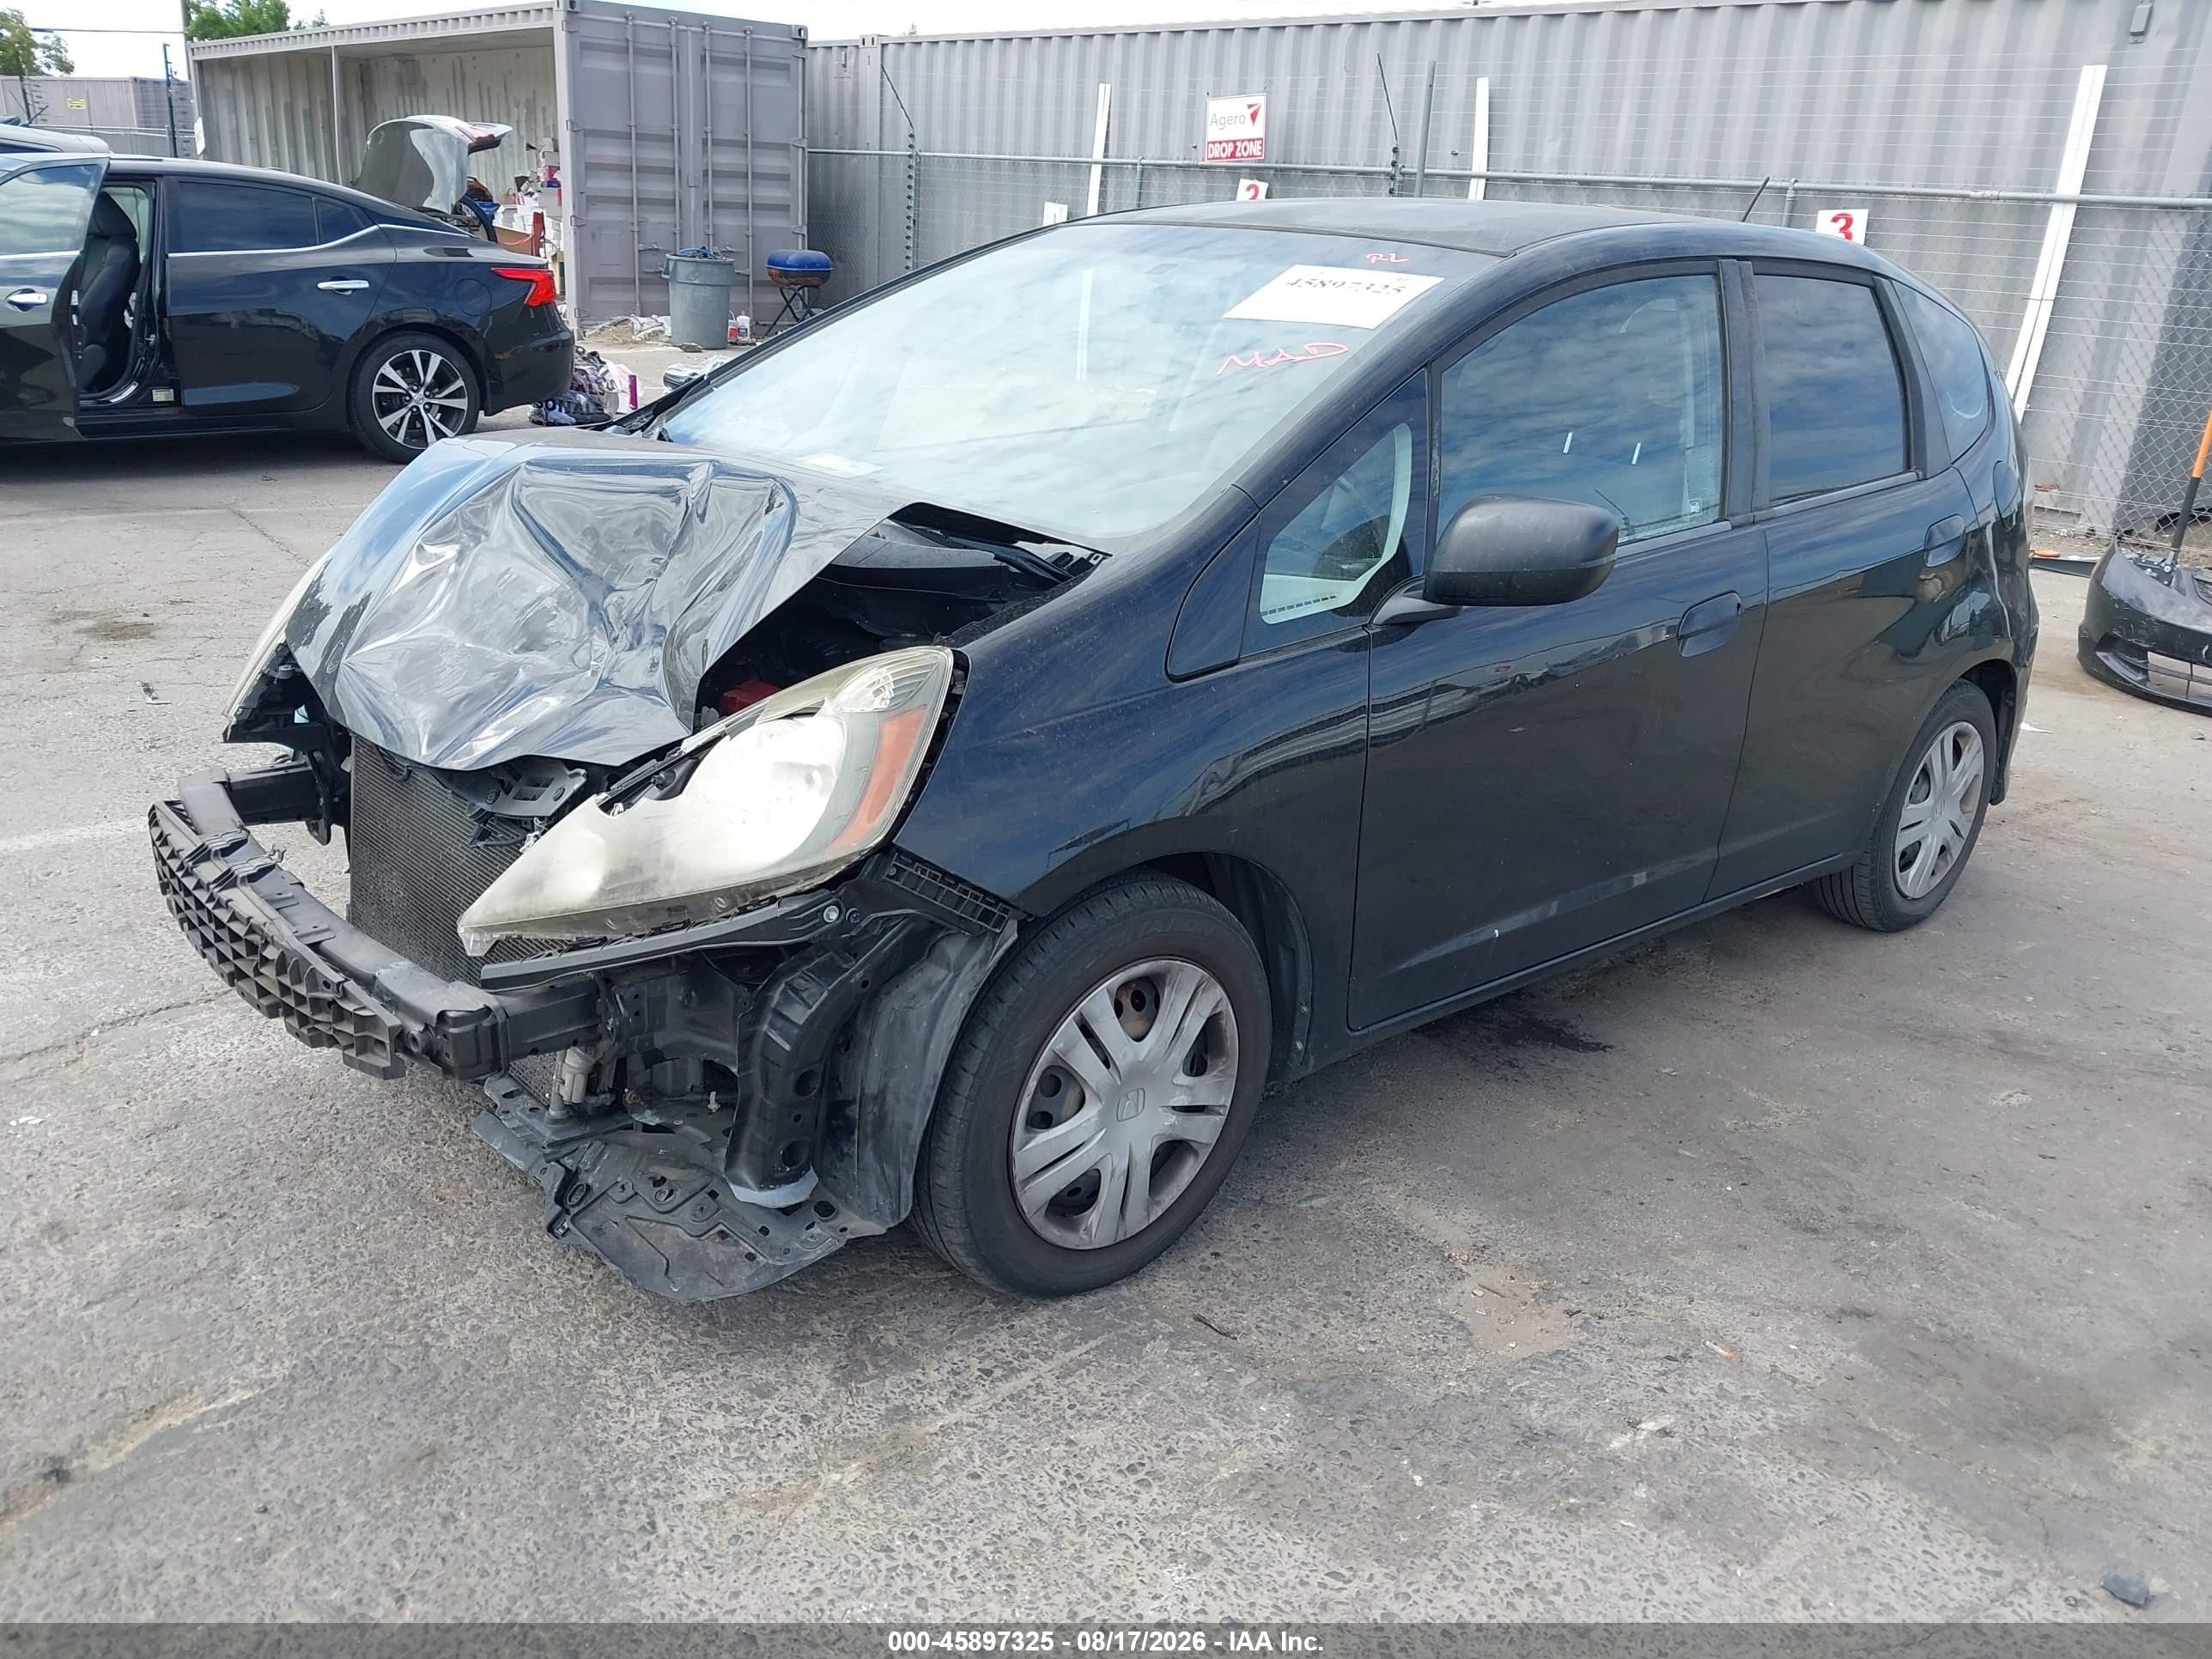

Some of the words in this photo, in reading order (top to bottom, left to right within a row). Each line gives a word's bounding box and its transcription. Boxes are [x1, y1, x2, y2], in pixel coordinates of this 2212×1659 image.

[1210, 112, 1246, 130] Agero
[1207, 142, 1234, 159] DROP
[1234, 139, 1262, 158] ZONE
[1245, 183, 1260, 201] 2
[1830, 212, 1854, 242] 3
